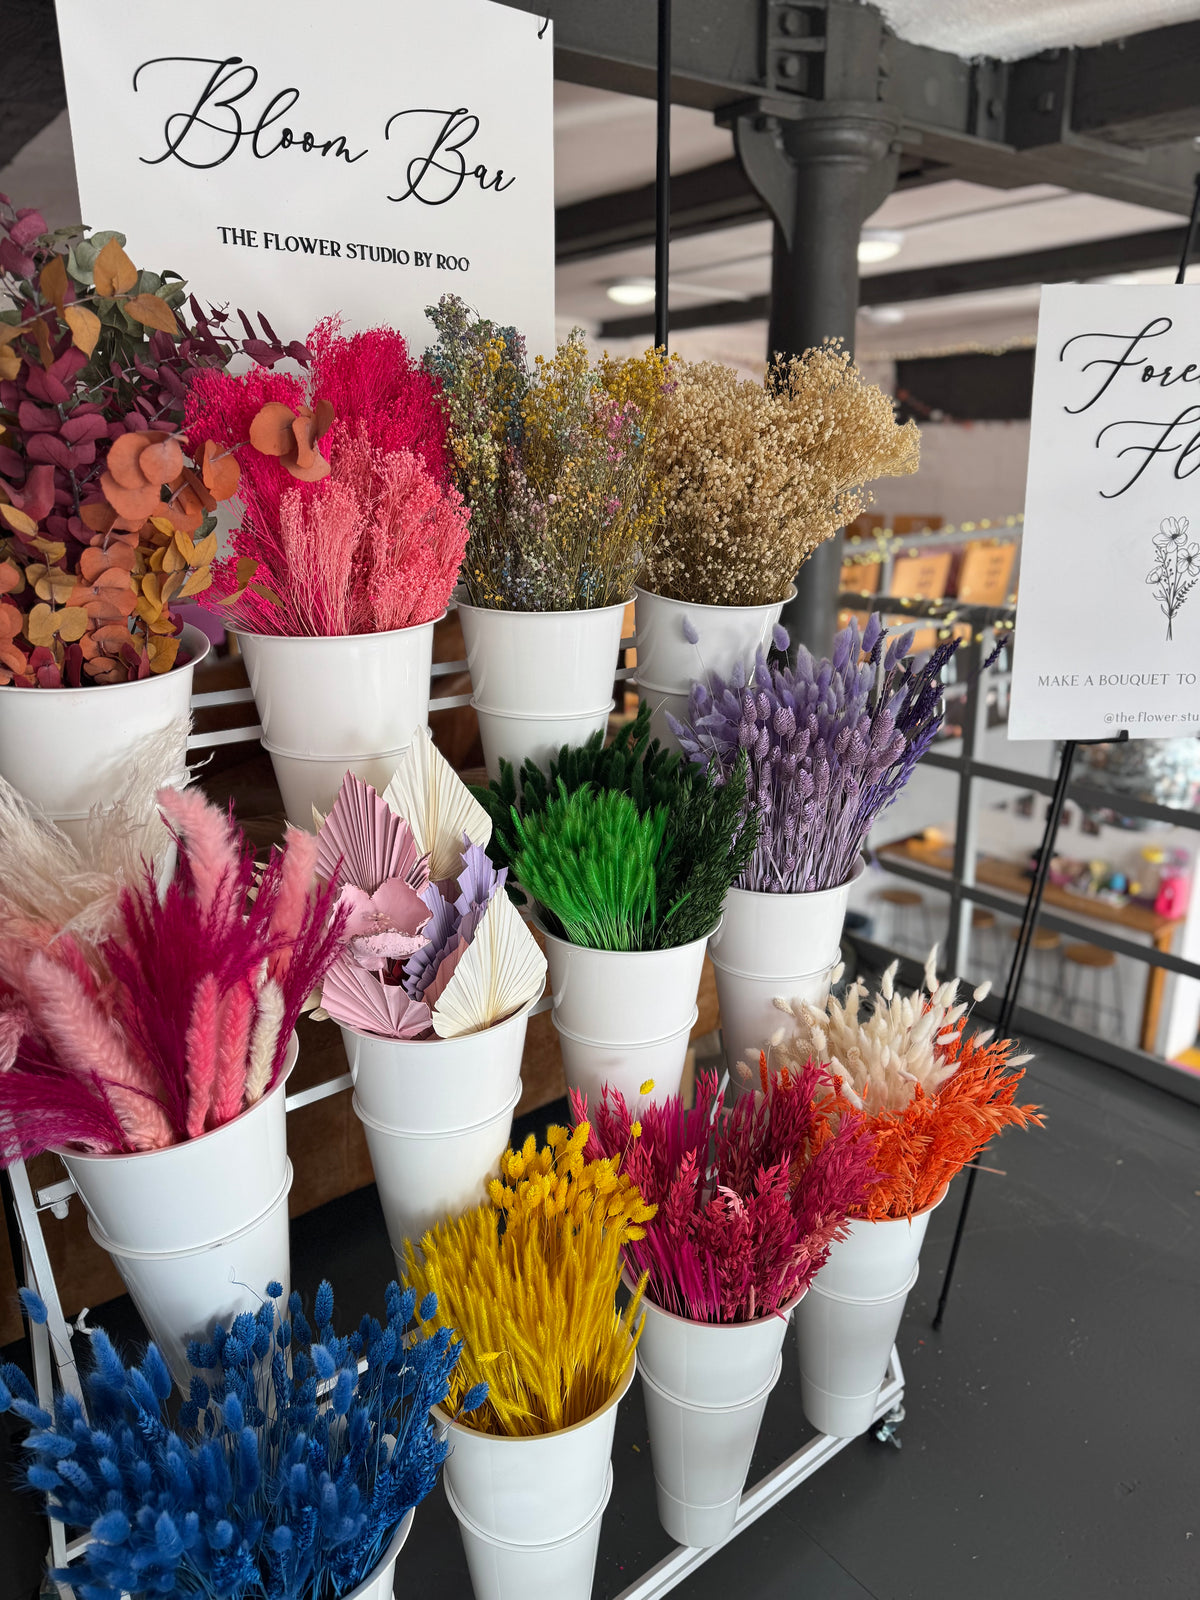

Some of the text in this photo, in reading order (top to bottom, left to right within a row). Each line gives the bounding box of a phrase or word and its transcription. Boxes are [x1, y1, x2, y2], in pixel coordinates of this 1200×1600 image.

[132, 56, 517, 206] Bloom Bar
[216, 226, 471, 273] THE FLOWER STUDIO BY ROO
[1037, 673, 1197, 687] MAKE A BOUQUET TO
